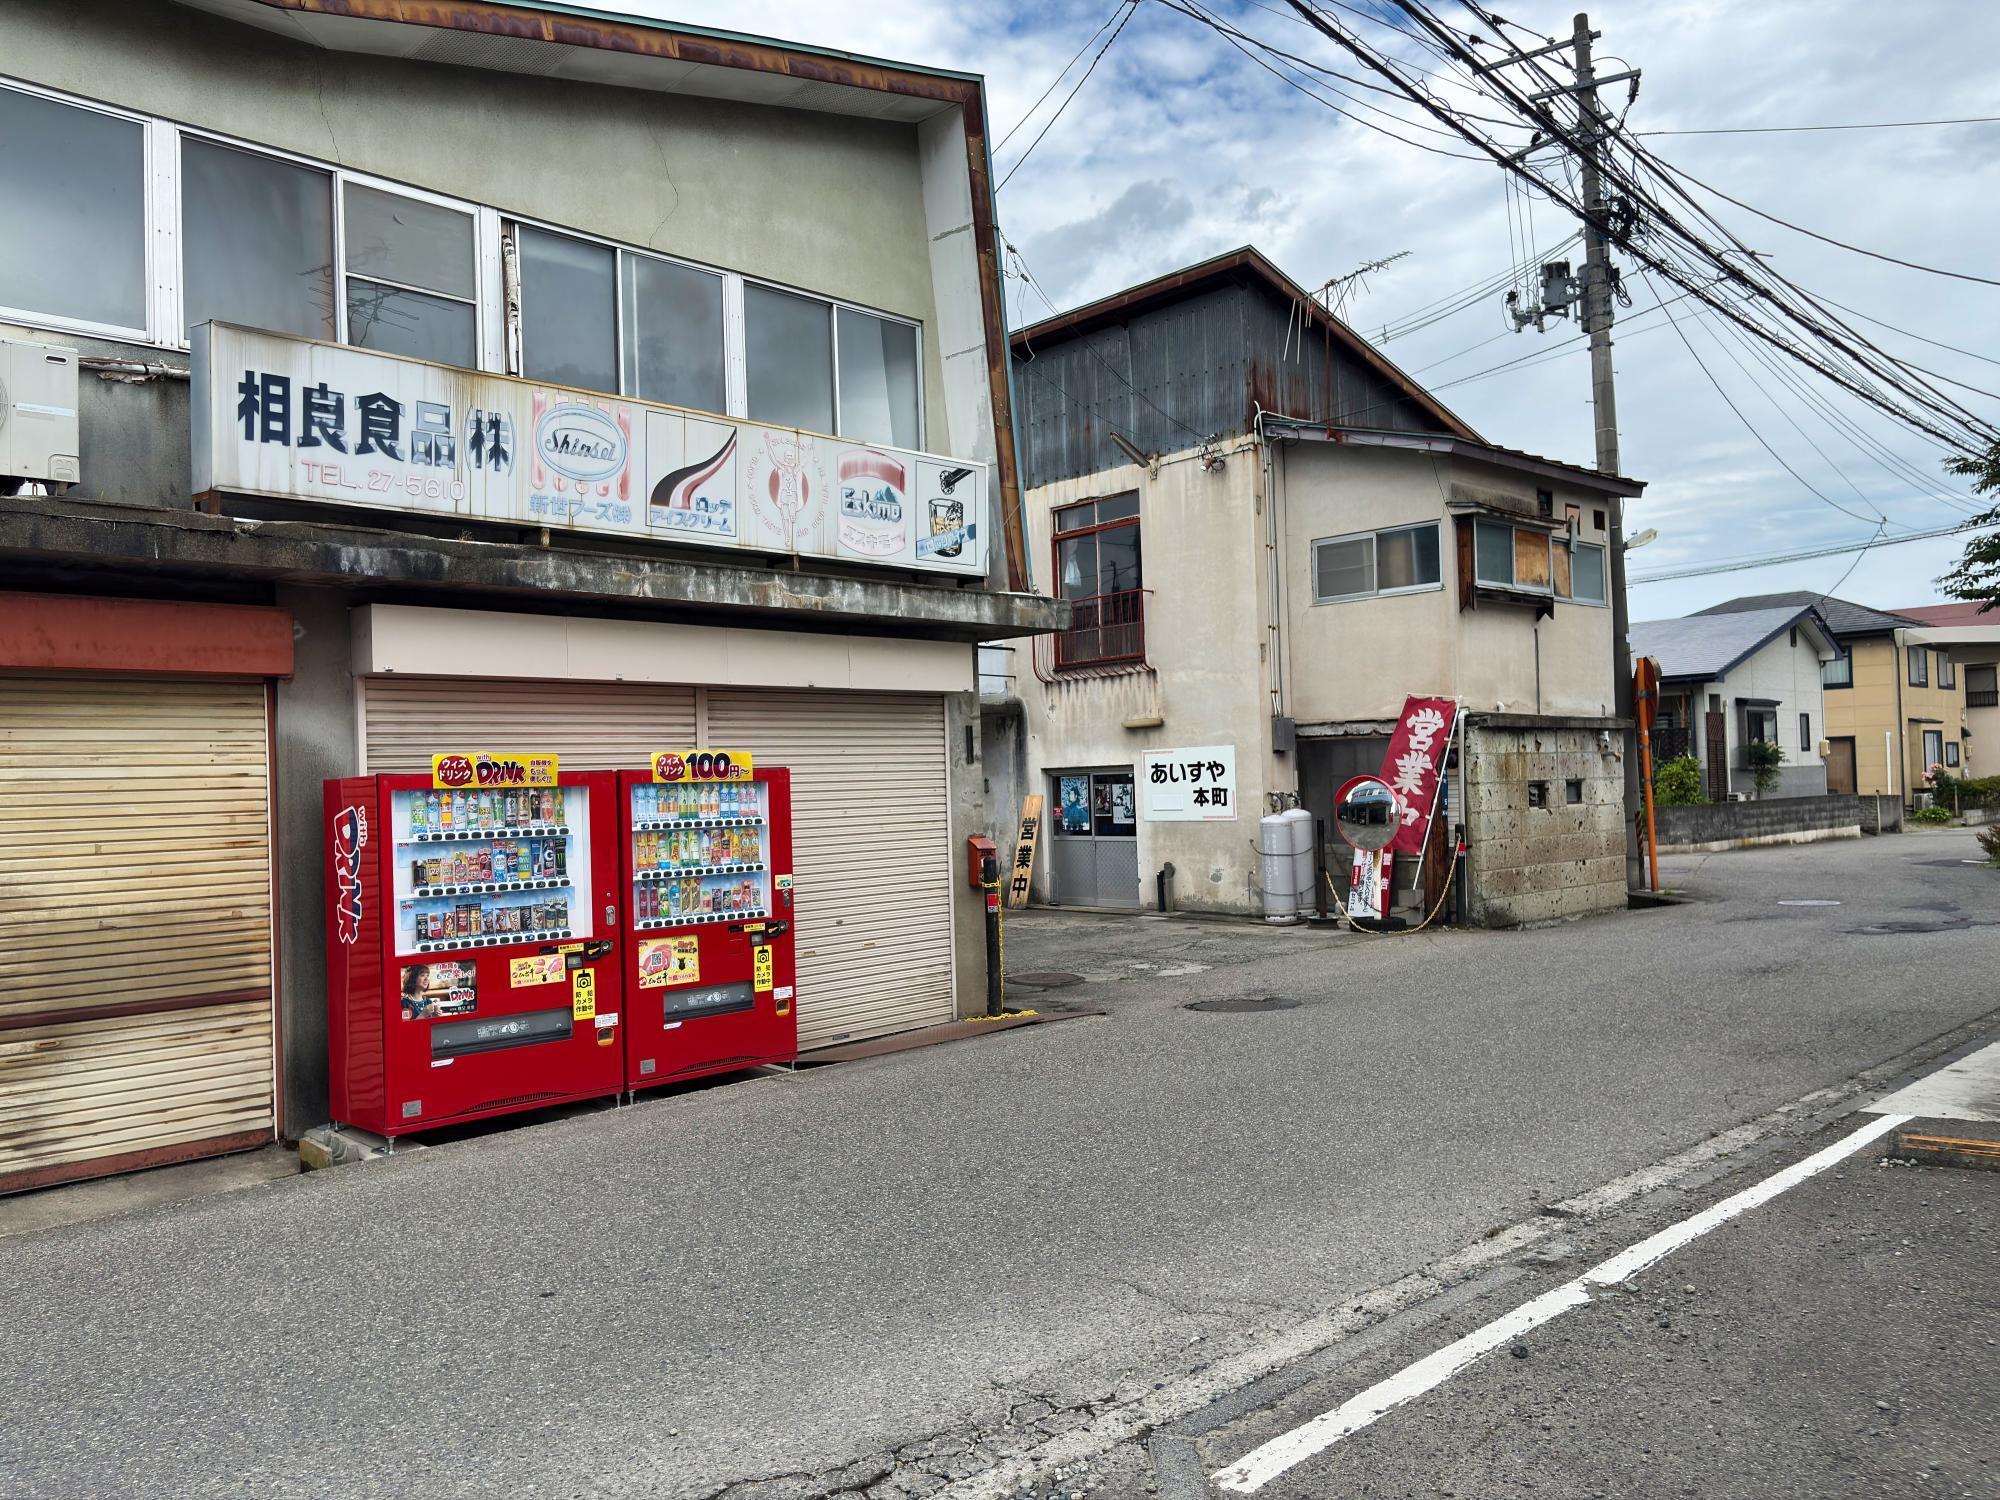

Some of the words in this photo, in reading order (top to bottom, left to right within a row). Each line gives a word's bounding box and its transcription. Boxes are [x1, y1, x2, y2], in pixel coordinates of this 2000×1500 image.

[695, 496, 732, 515] ロッテ
[442, 758, 468, 769] ウィズ
[657, 765, 684, 776] ドリンク
[659, 756, 681, 766] ウィズ
[439, 769, 471, 781] ドリンク
[476, 760, 527, 786] DRINK
[1151, 761, 1226, 784] あいすや
[1193, 787, 1228, 807] 本町
[358, 806, 368, 847] with
[1013, 817, 1037, 898] 営業中
[334, 806, 363, 945] DRINK
[576, 990, 593, 998] 防犯
